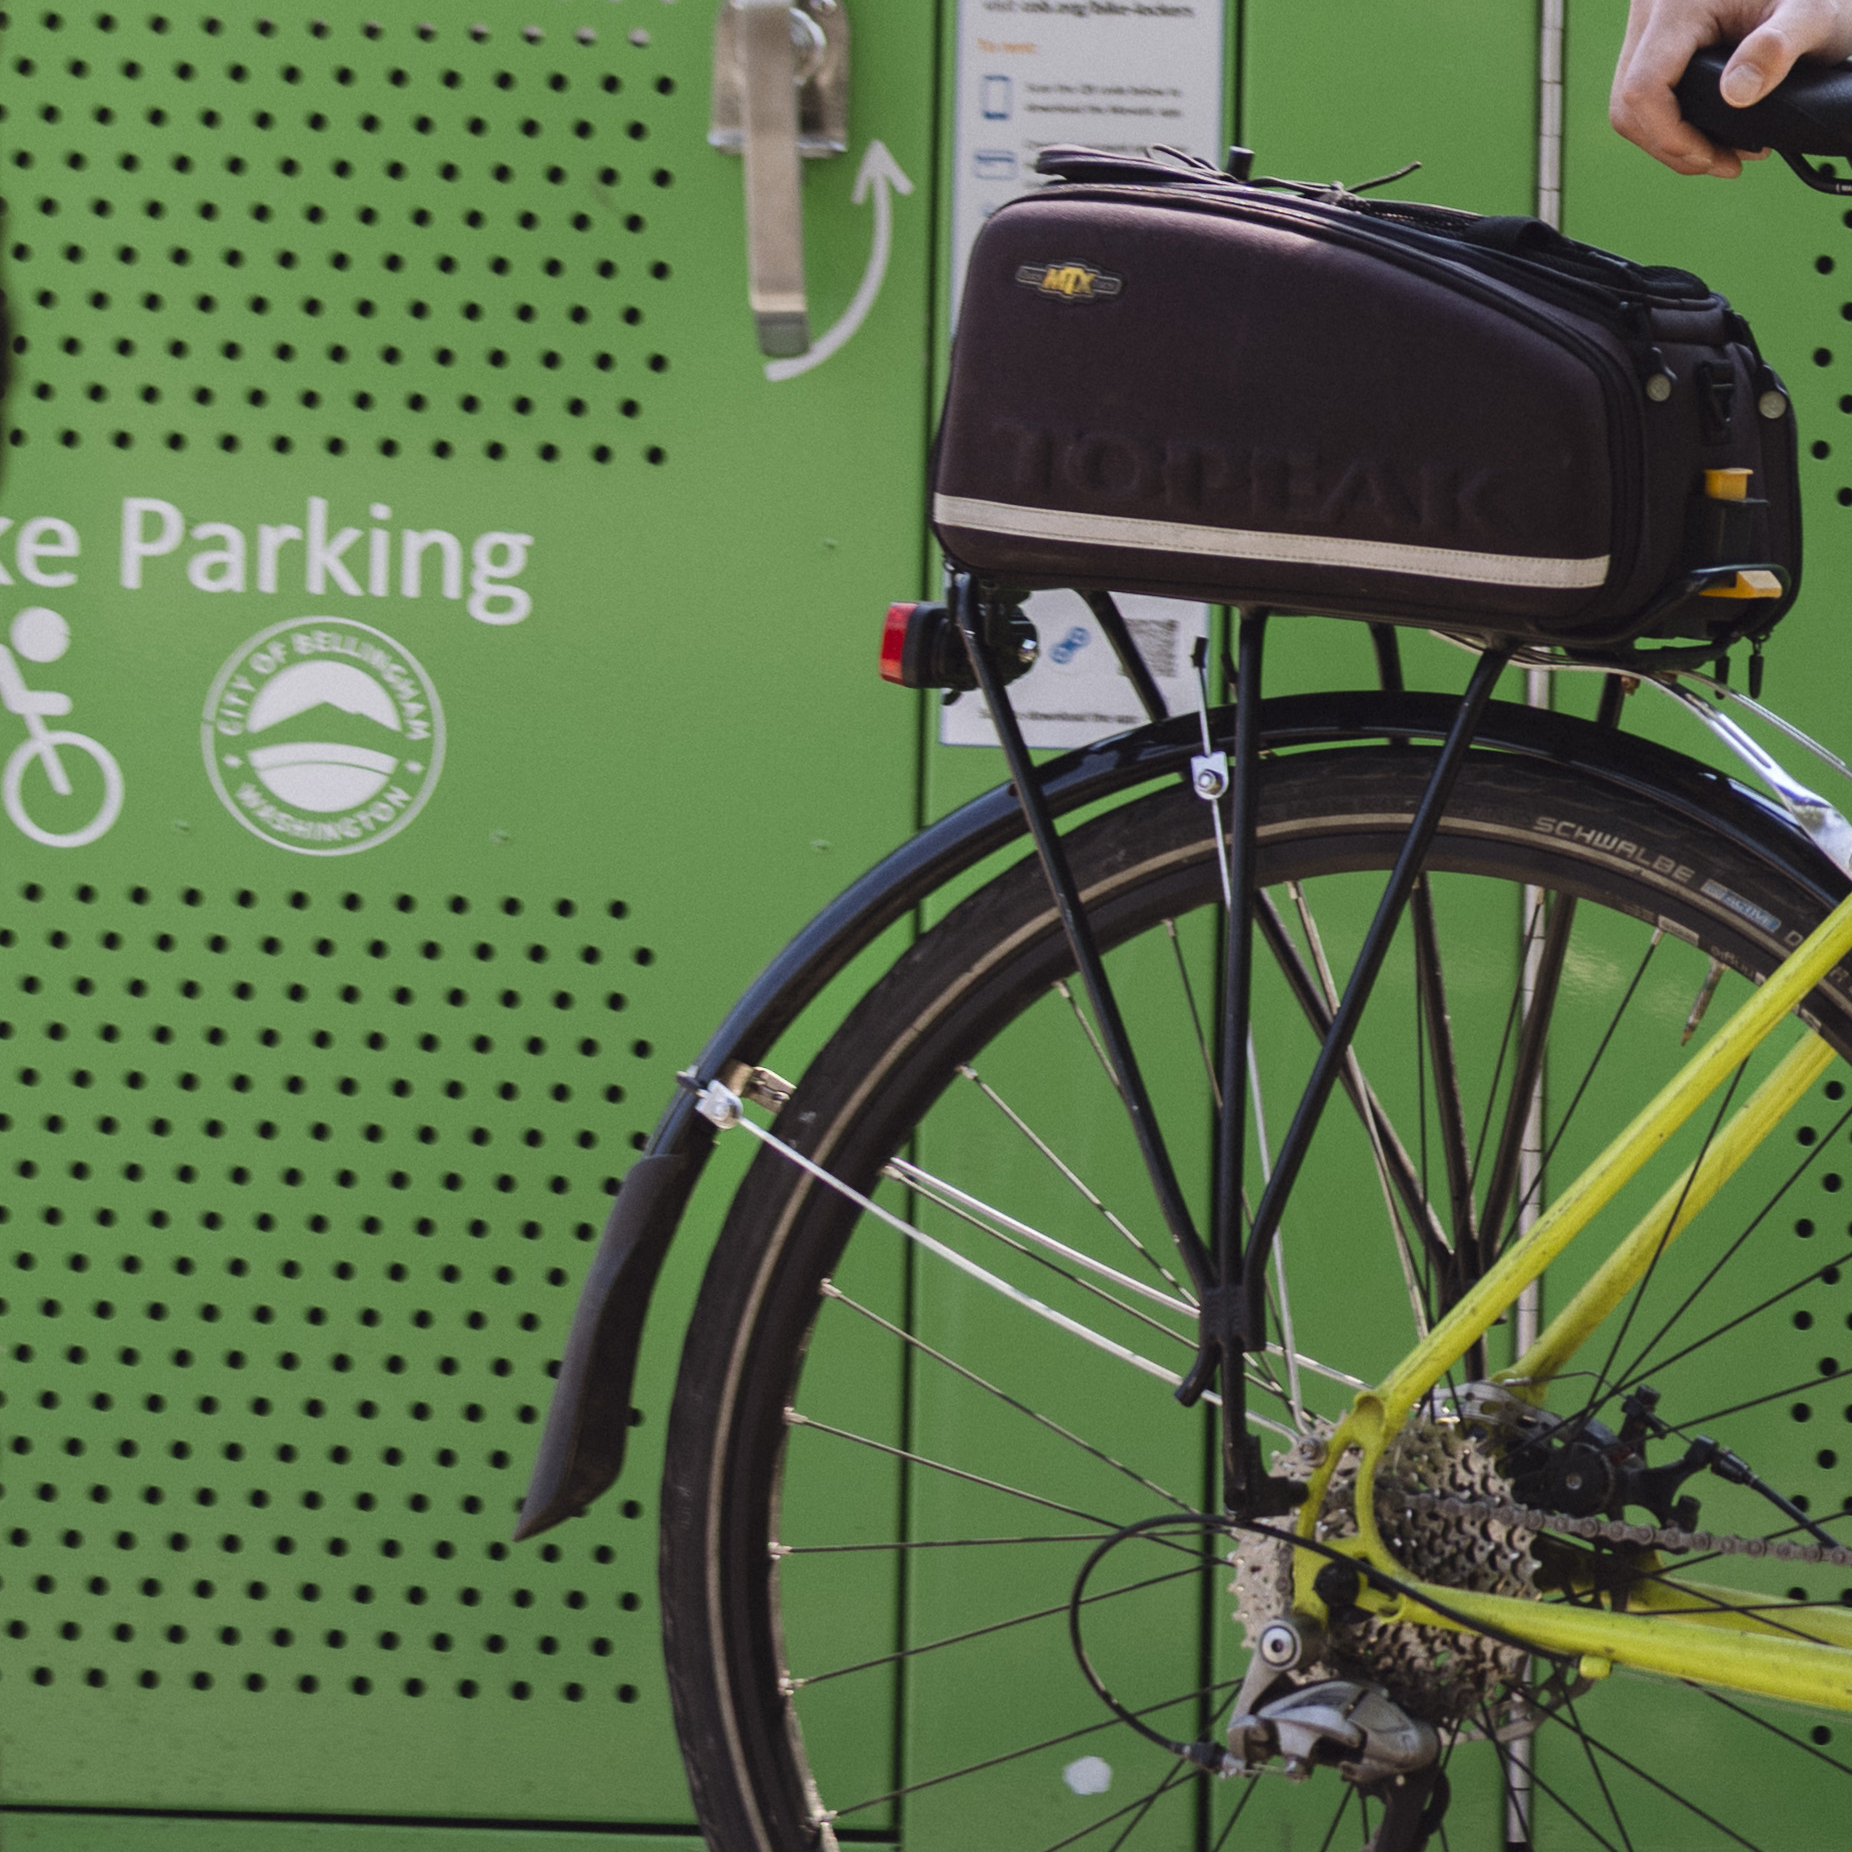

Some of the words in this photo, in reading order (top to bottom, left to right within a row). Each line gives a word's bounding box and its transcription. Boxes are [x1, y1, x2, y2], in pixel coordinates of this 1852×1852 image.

[1041, 266, 1097, 295] MTX
[992, 421, 1510, 532] TOPEAK
[121, 497, 534, 626] Parking
[217, 673, 256, 737] CITY
[249, 641, 289, 676] OF
[291, 630, 432, 741] BELLINGHAM
[236, 781, 412, 842] WASHINGTON
[1533, 815, 1697, 885] SCHWALBE
